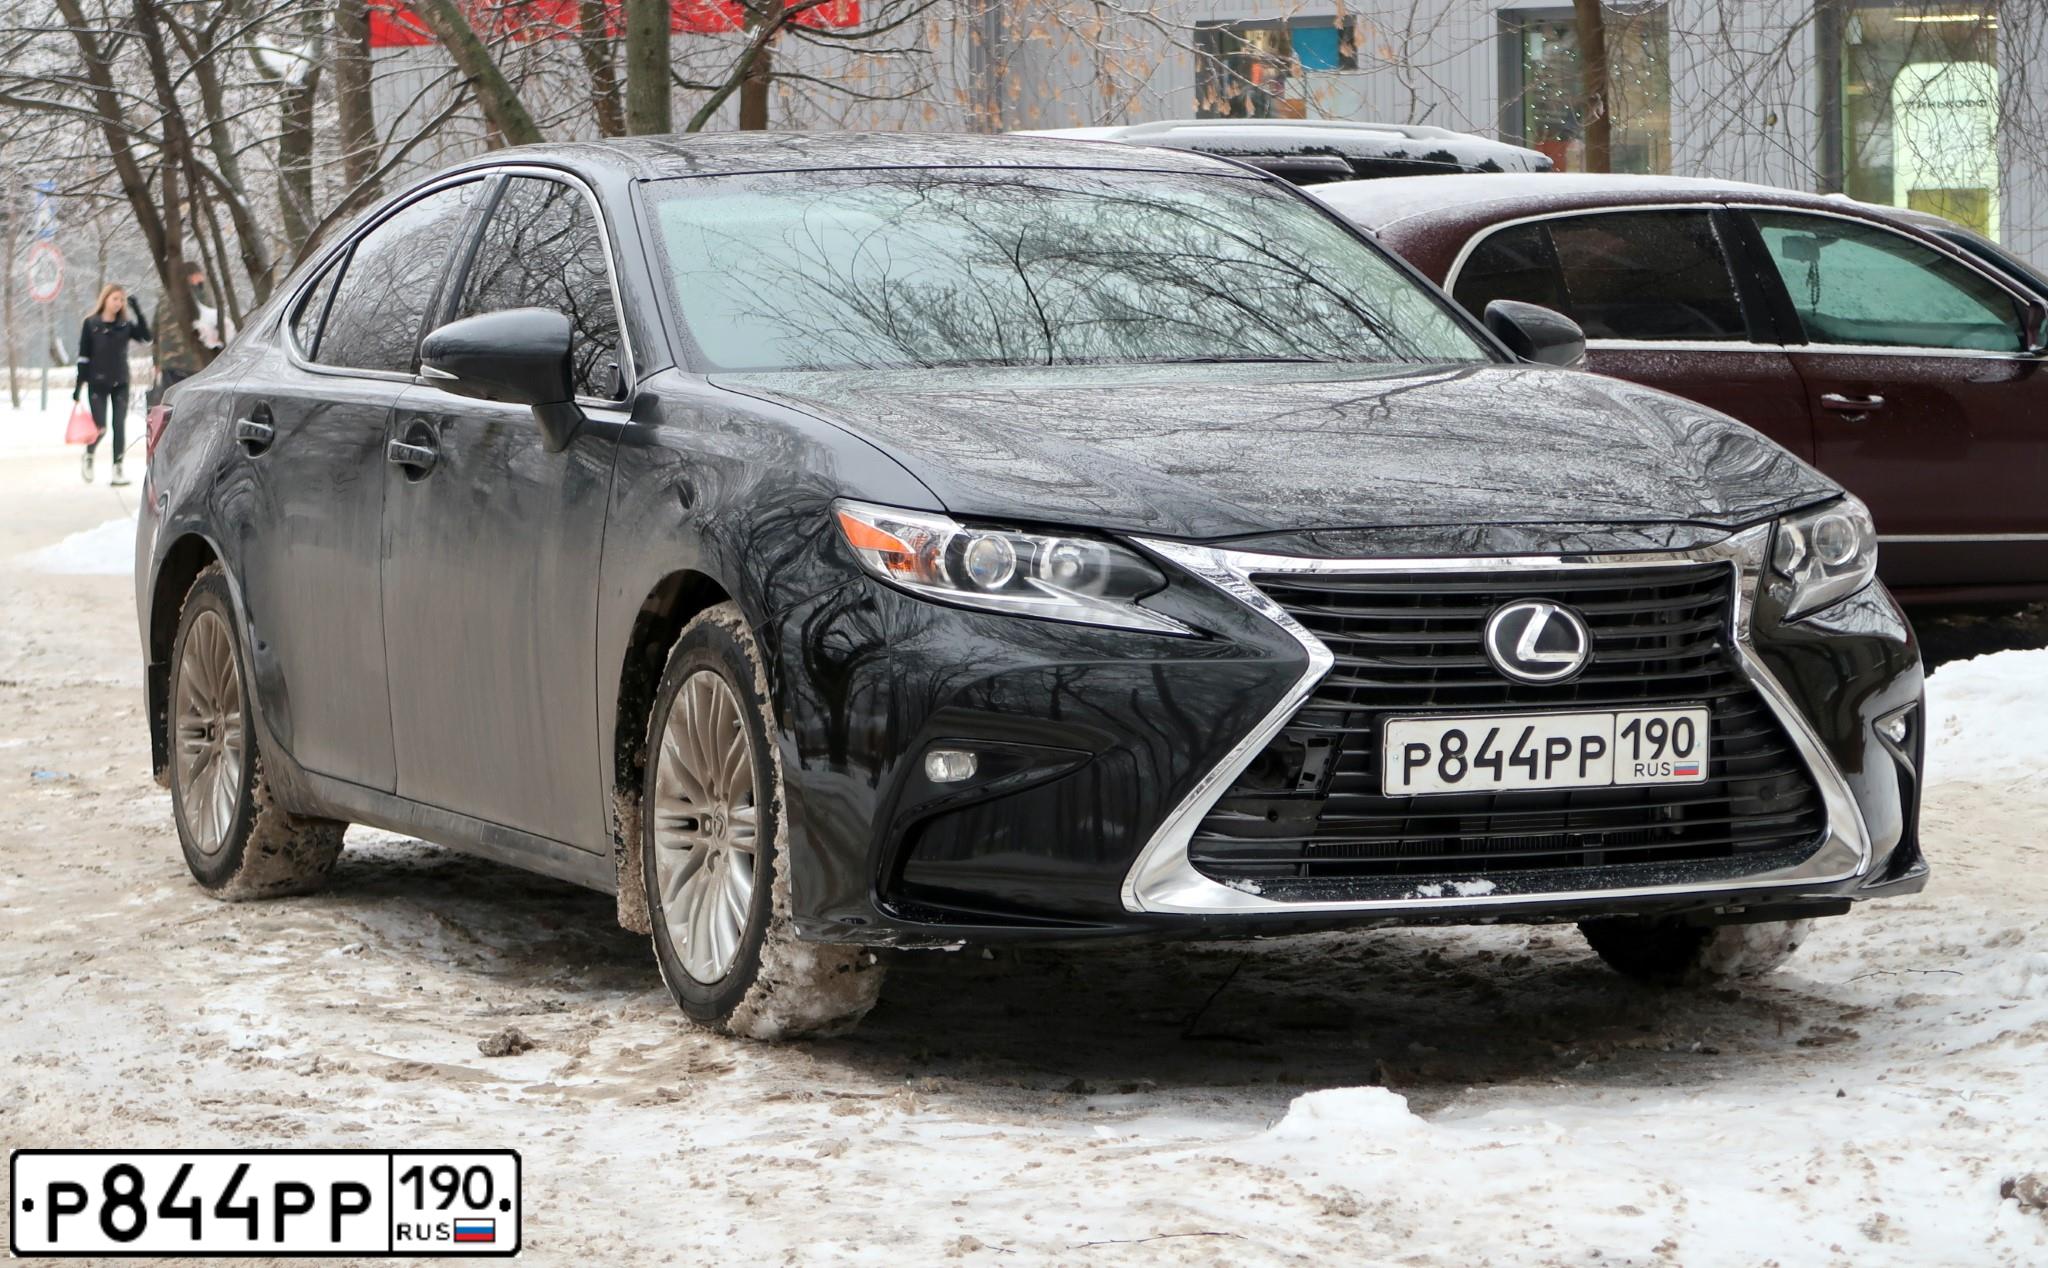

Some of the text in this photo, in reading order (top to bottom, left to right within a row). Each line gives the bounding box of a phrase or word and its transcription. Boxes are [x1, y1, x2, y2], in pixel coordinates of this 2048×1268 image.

[1403, 716, 1695, 786] P844PP 190
[1634, 762, 1671, 777] RUS
